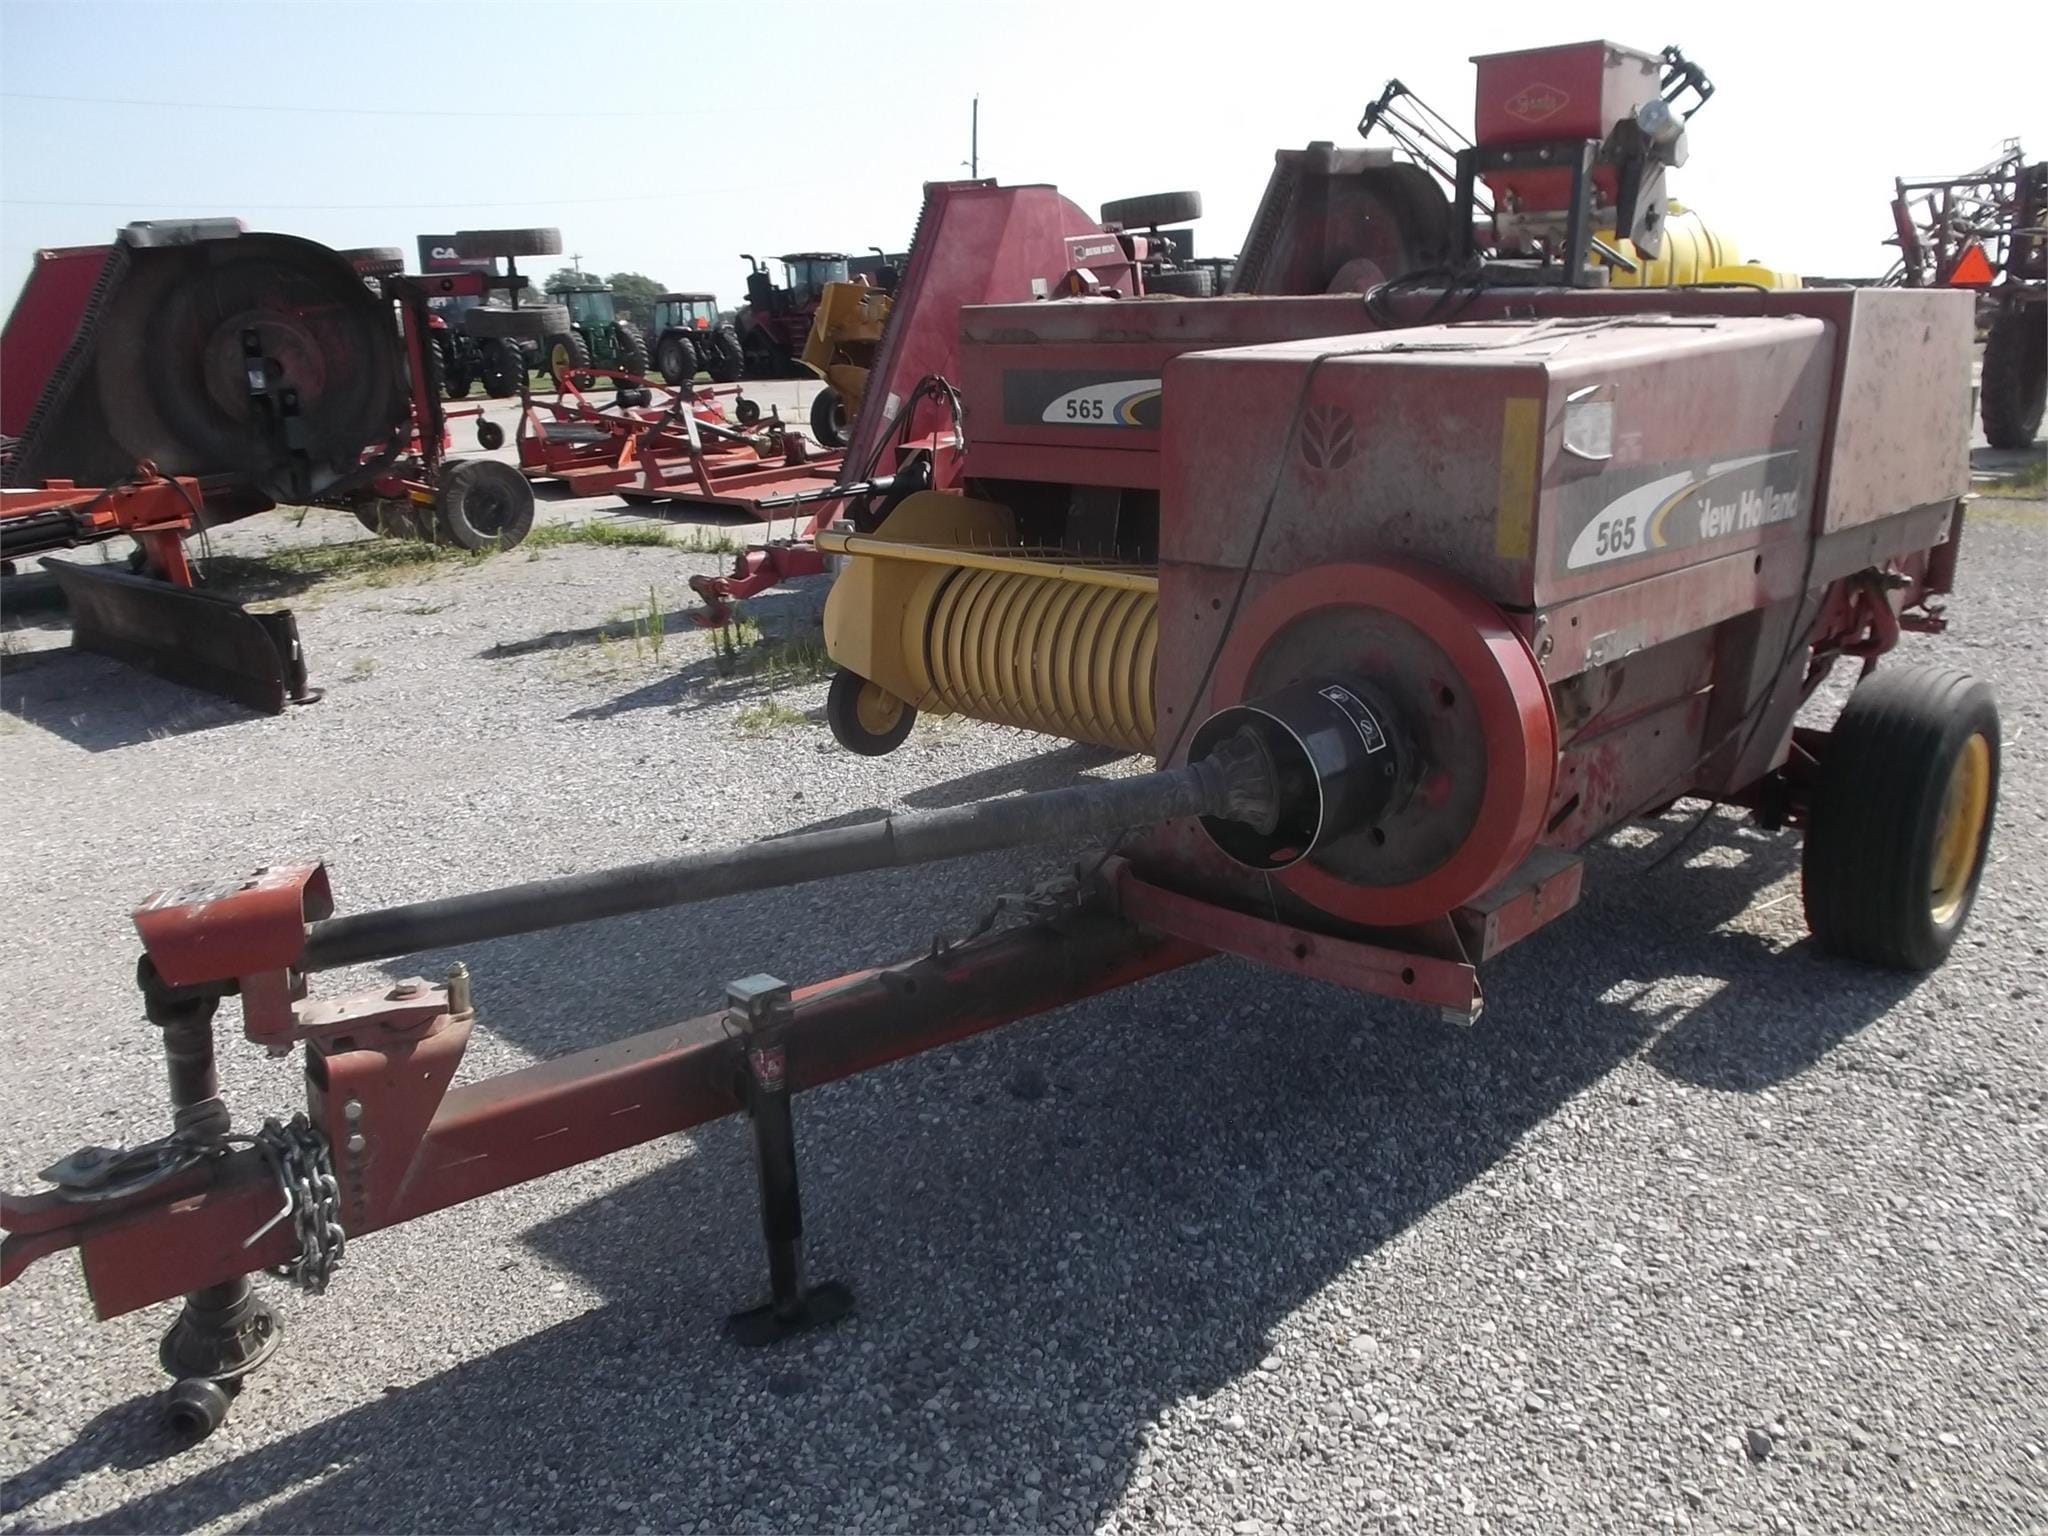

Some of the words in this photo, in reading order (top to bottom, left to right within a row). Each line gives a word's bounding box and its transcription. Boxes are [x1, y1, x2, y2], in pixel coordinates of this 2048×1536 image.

[431, 247, 459, 259] CA
[1066, 399, 1104, 419] 565
[1595, 516, 1636, 557] 565
